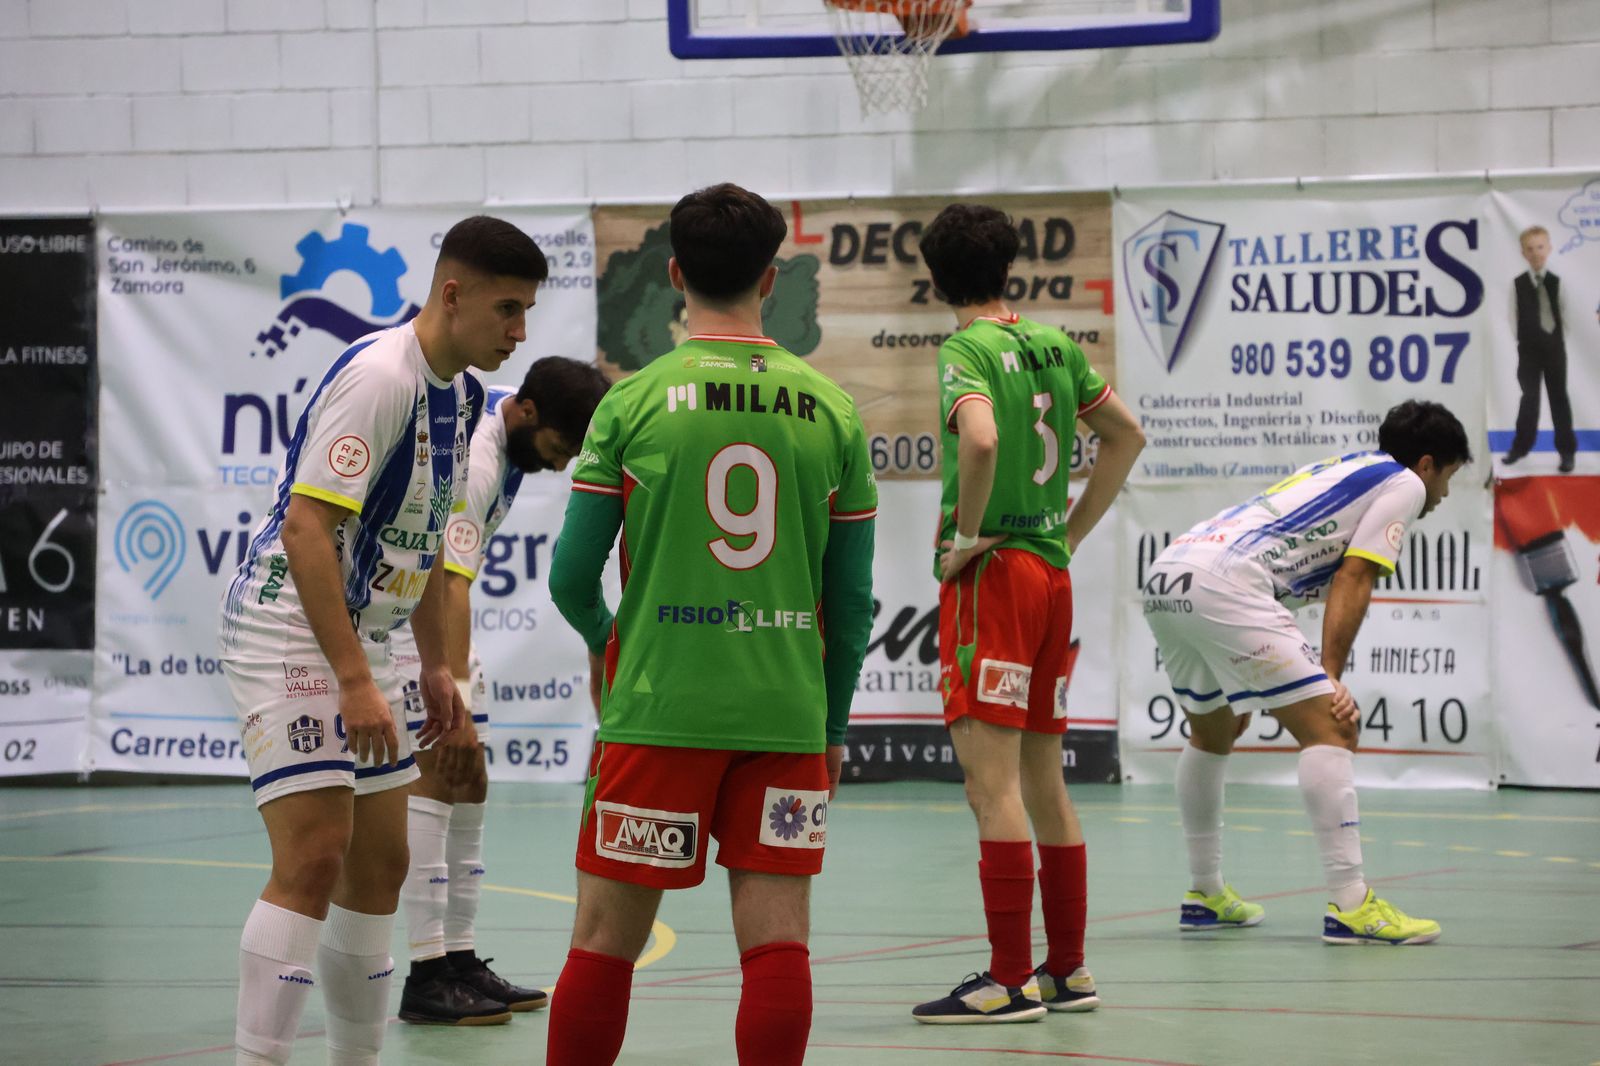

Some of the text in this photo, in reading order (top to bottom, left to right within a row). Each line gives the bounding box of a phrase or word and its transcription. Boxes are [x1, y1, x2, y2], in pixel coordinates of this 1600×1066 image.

[107, 235, 205, 252] Camino de
[107, 254, 257, 276] San Jerónimo, 6
[110, 277, 185, 296] Zamora
[21, 345, 89, 364] FITNESS
[1231, 332, 1470, 384] 980 539 807
[705, 381, 817, 423] MILAR
[1139, 392, 1303, 409] Calderería Industrial
[1140, 409, 1382, 431] Proyectos, Ingeniería y Diseños
[38, 440, 63, 459] DE
[1030, 391, 1059, 486] 3
[1263, 429, 1336, 447] Metálicas
[1342, 434, 1350, 450] y
[871, 436, 935, 470] 608
[1143, 461, 1296, 478] Villaralbo (Zamora)
[706, 442, 779, 571] 9
[28, 507, 75, 593] 6
[380, 527, 430, 552] CAJA
[473, 607, 538, 632] ICIOS
[1392, 609, 1441, 621] GAS
[282, 661, 309, 680] LOS
[1370, 647, 1457, 674] HINIESTA
[160, 654, 188, 674] de
[492, 676, 583, 702] lavado"
[285, 679, 328, 693] VALLES
[286, 690, 328, 699] RESTAURANTE
[1412, 697, 1469, 745] 10
[4, 739, 37, 762] 02
[506, 738, 570, 771] 62,5
[605, 816, 685, 857] AMAQ
